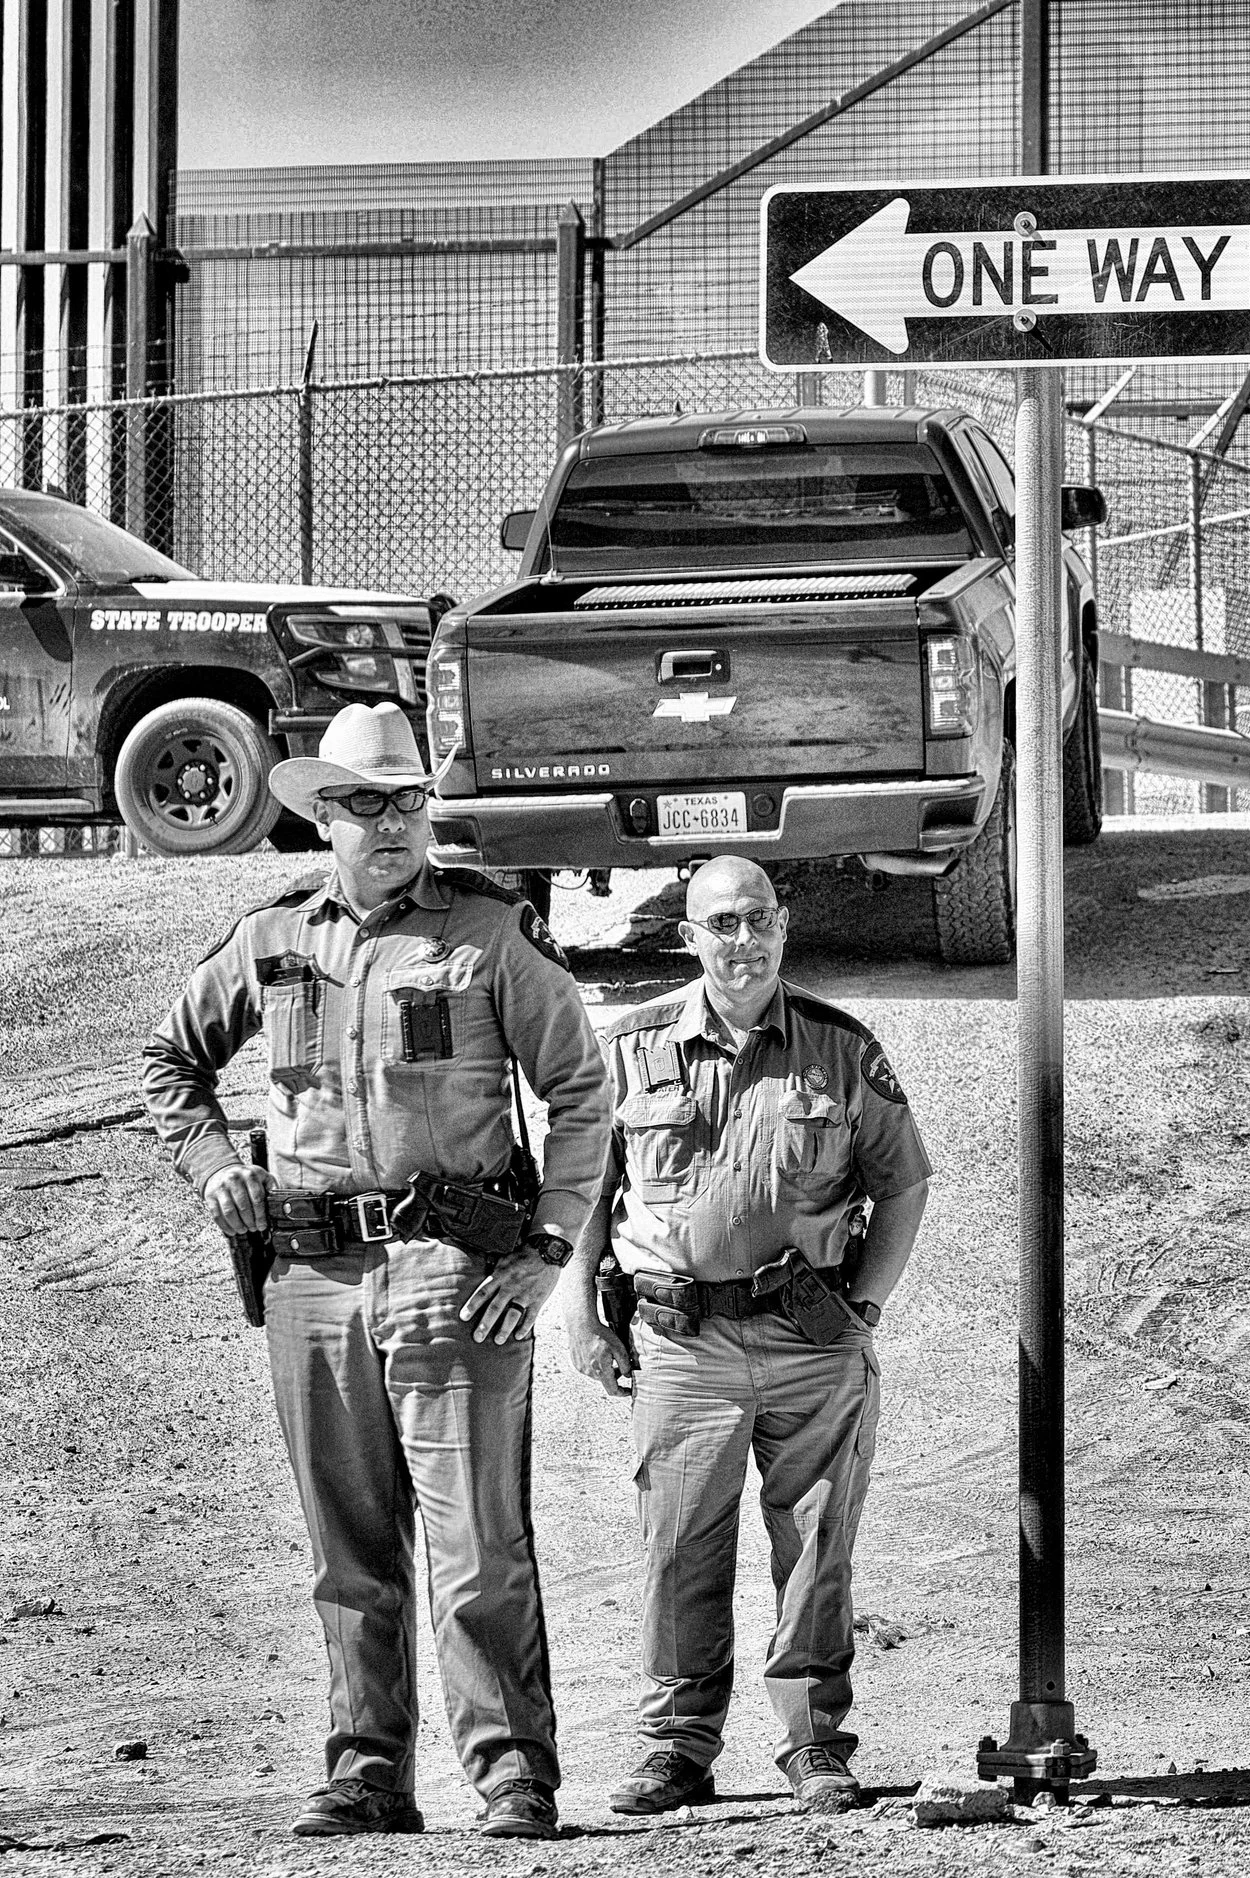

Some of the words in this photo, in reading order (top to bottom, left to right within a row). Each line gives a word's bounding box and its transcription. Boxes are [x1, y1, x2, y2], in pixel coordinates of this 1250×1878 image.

[922, 239, 1059, 309] ONE
[1087, 235, 1231, 303] WAY
[90, 610, 161, 631] STATE
[167, 611, 268, 634] TROOPER
[491, 764, 610, 779] SILVERADO
[684, 796, 718, 806] TEXAS
